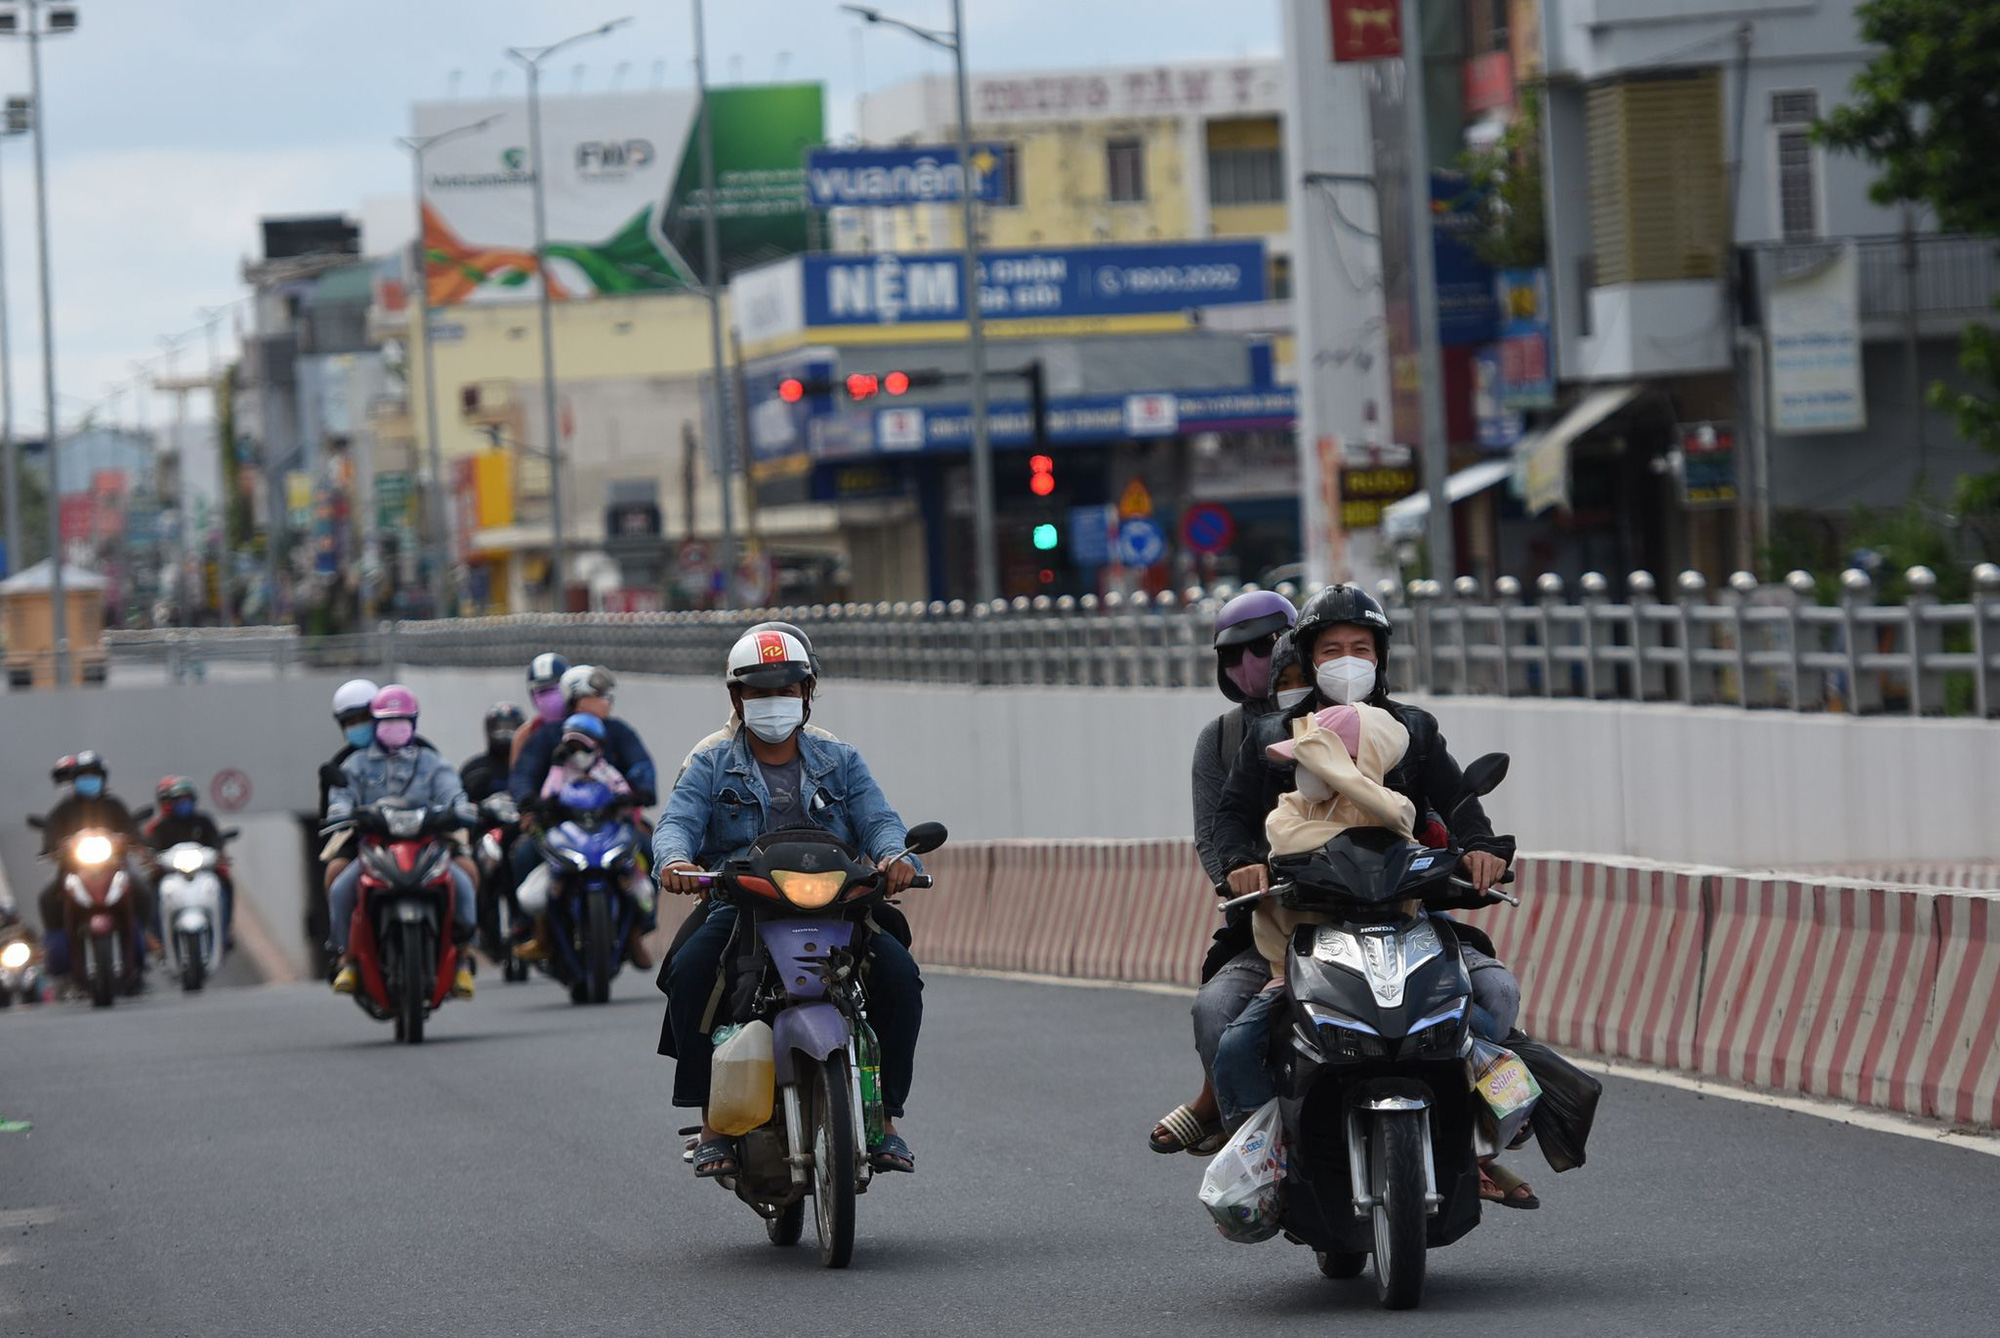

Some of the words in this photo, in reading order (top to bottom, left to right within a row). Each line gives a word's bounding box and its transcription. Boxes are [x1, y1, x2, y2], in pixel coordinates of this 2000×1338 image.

[828, 254, 959, 325] NỆM
[1360, 925, 1397, 934] HONDA
[1489, 1067, 1518, 1096] Solite
